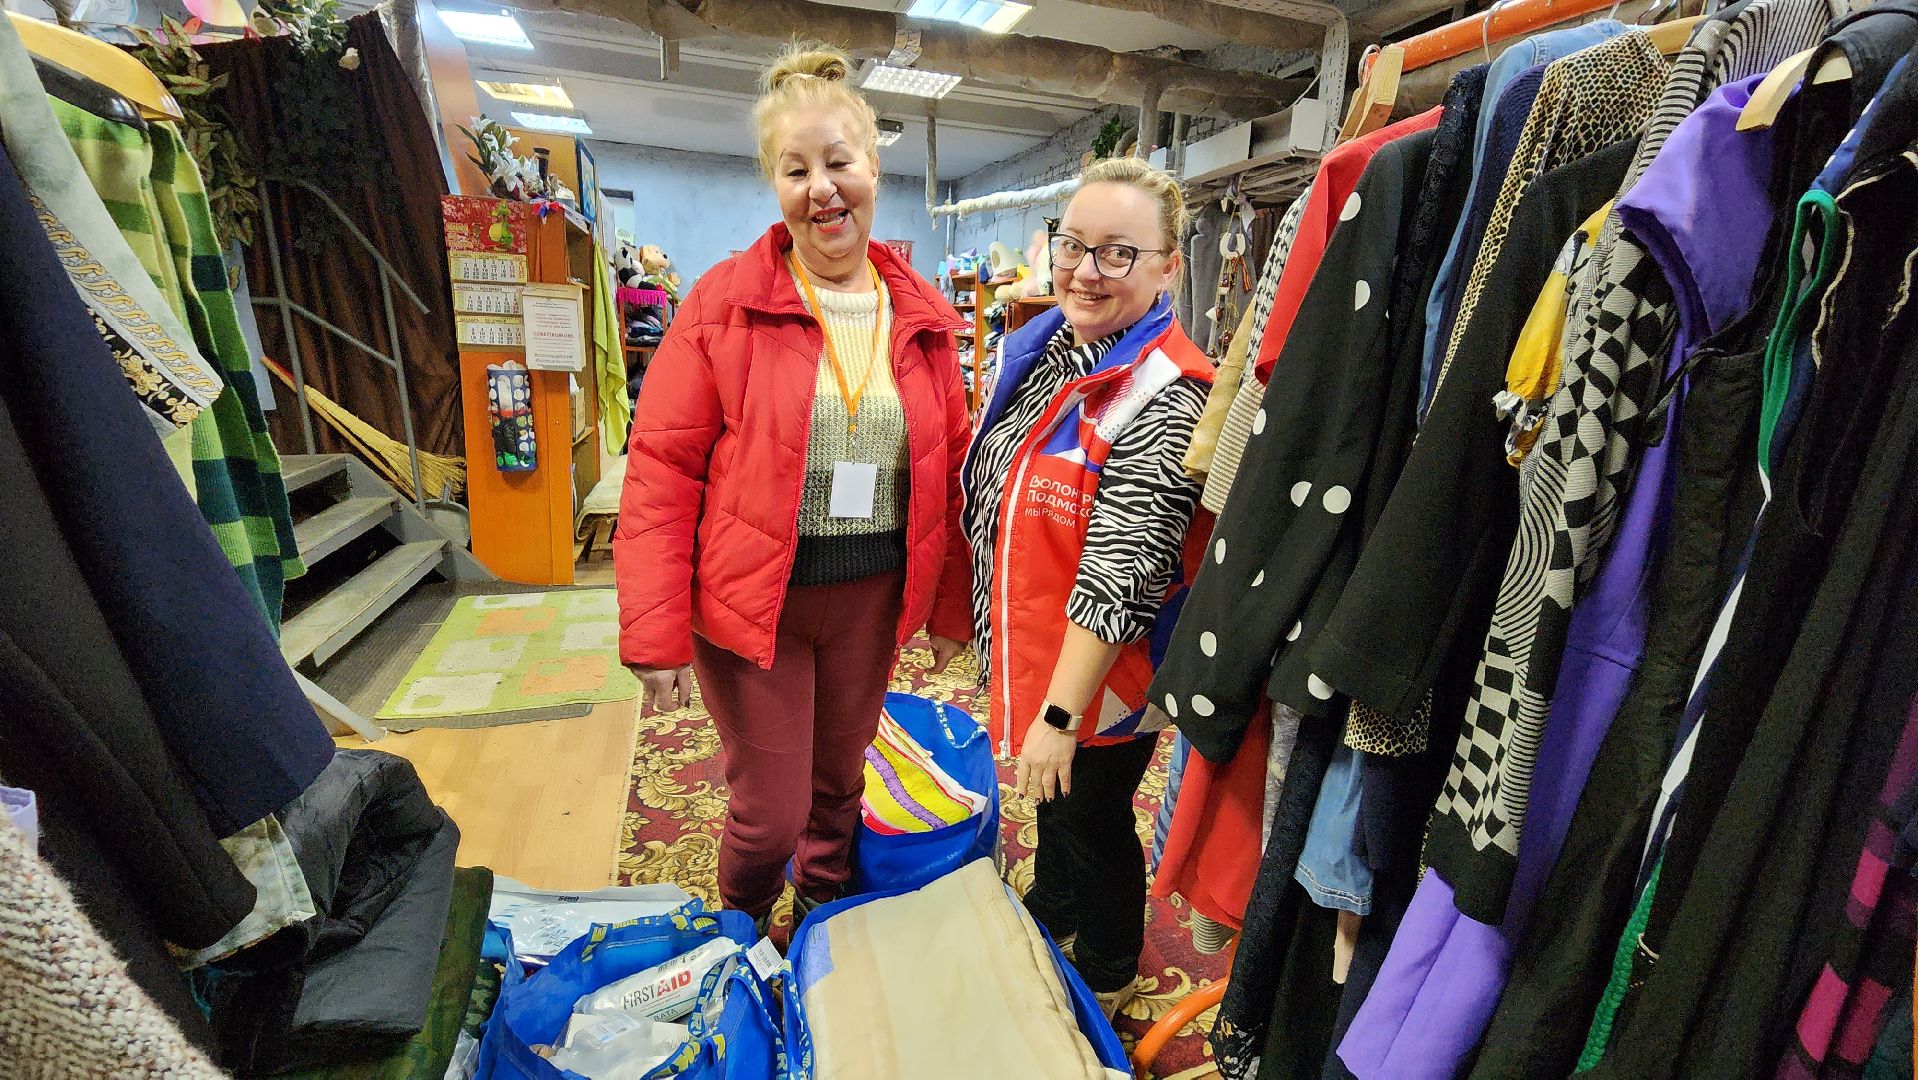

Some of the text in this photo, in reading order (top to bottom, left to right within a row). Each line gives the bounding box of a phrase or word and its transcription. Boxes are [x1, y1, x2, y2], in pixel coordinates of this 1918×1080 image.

[1024, 507, 1076, 528] МЫ РЯДОМ
[623, 983, 655, 1010] FIRST
[657, 970, 692, 998] AID
